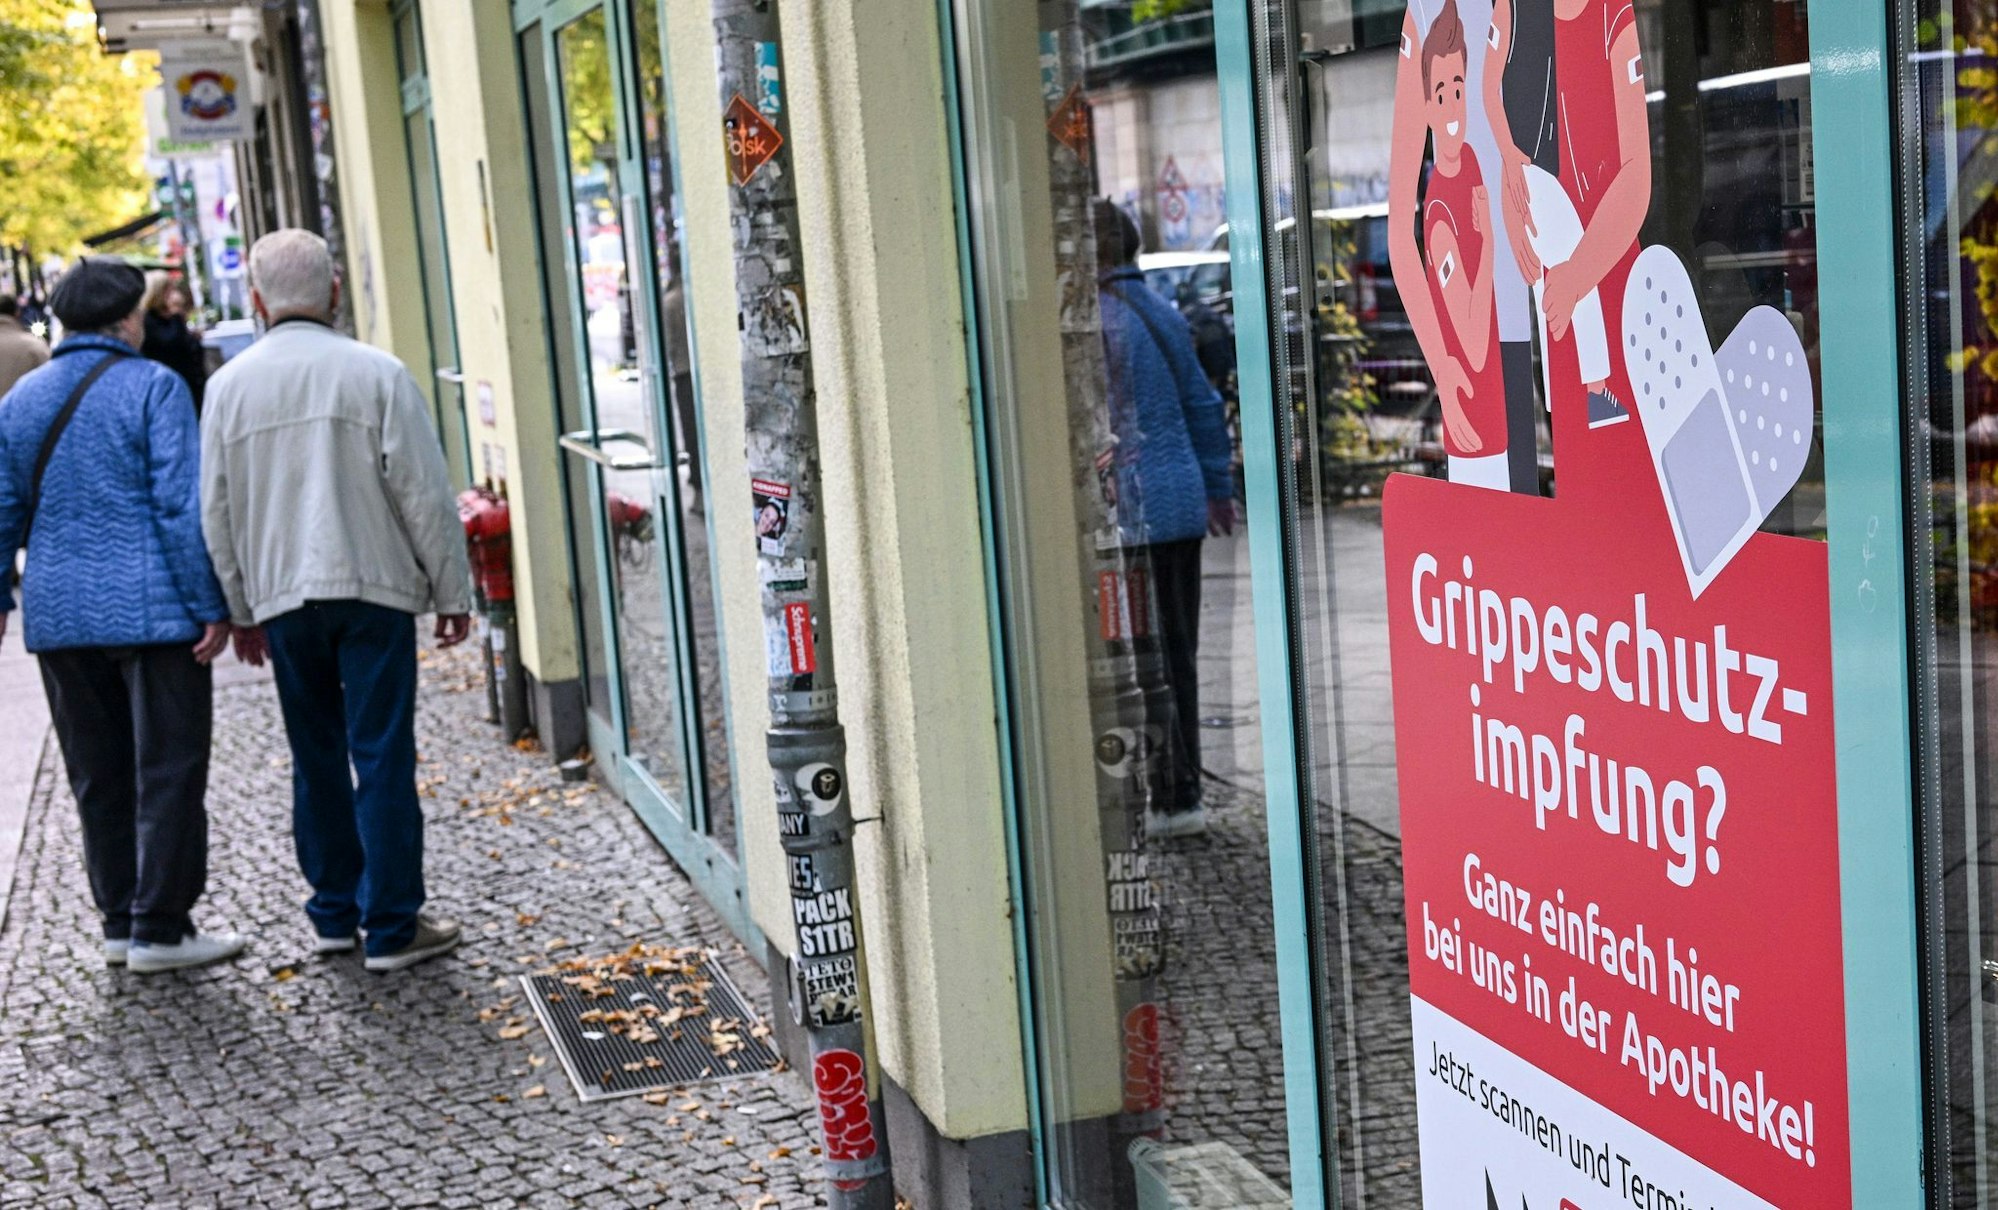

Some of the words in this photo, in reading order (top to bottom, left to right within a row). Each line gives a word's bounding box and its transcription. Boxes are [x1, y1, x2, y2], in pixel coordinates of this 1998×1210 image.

[1412, 552, 1808, 745] Grippeschutz-
[1470, 682, 1727, 888] impfung?
[794, 888, 852, 924] PACK
[1463, 852, 1533, 934] Ganz
[1539, 888, 1658, 996] einfach
[1667, 937, 1740, 1032] hier
[1422, 901, 1463, 975] bei
[1469, 941, 1516, 1004] uns
[1522, 953, 1551, 1024] in
[1558, 976, 1611, 1055] der
[1620, 1011, 1816, 1168] Apotheke!
[1429, 1041, 1476, 1101] Jetzt
[1480, 1078, 1562, 1157] scannen
[1569, 1134, 1610, 1188] und
